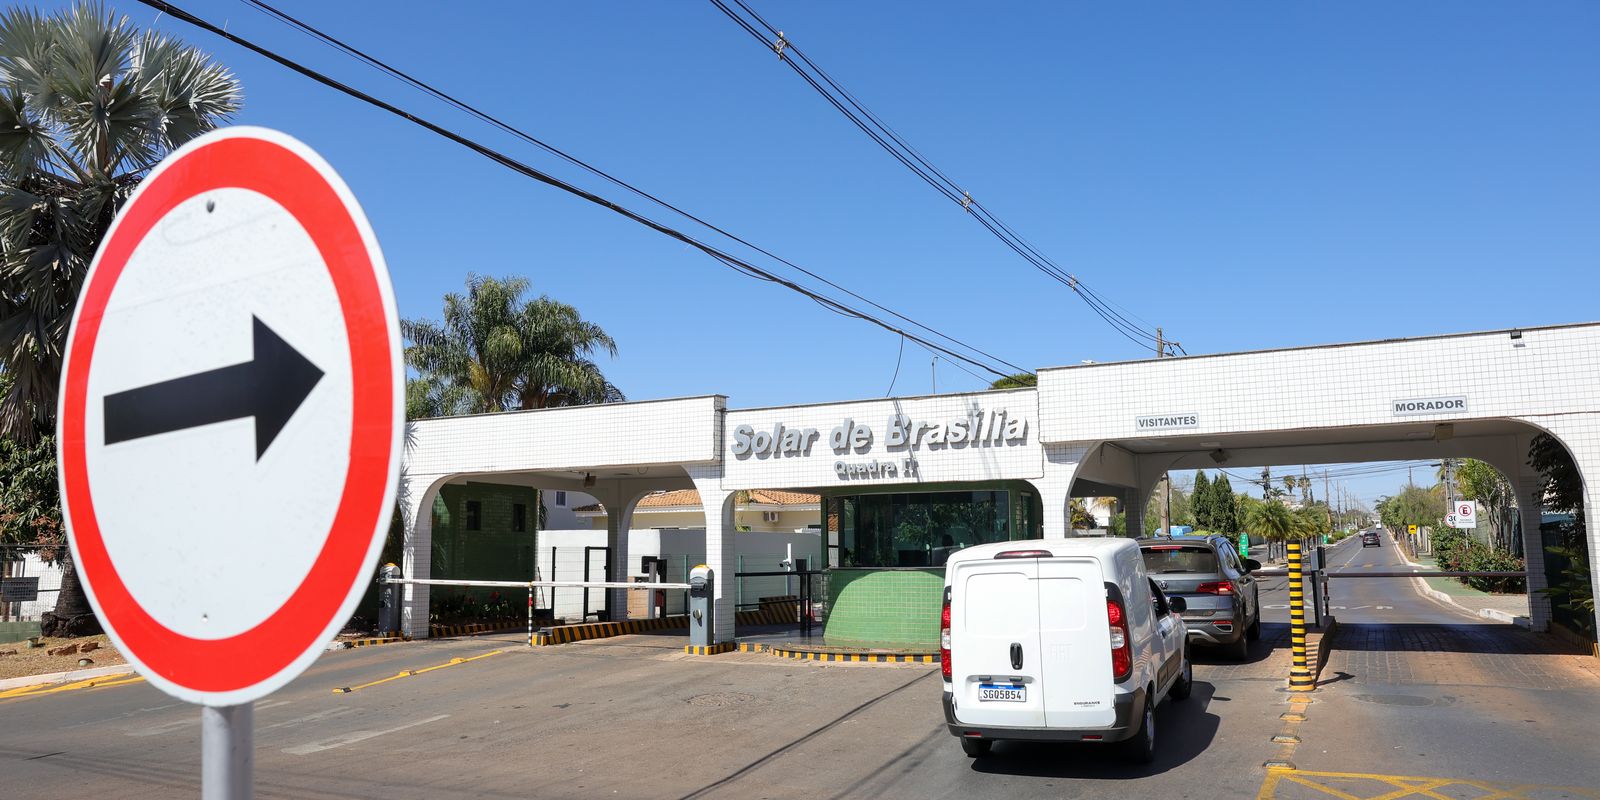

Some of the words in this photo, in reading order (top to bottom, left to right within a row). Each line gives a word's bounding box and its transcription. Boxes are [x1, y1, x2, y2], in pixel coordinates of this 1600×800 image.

[1395, 400, 1464, 412] MORADOR
[1139, 416, 1196, 427] VISITANTES
[731, 422, 819, 458] Solar
[829, 417, 873, 453] de
[834, 459, 897, 477] Quadra
